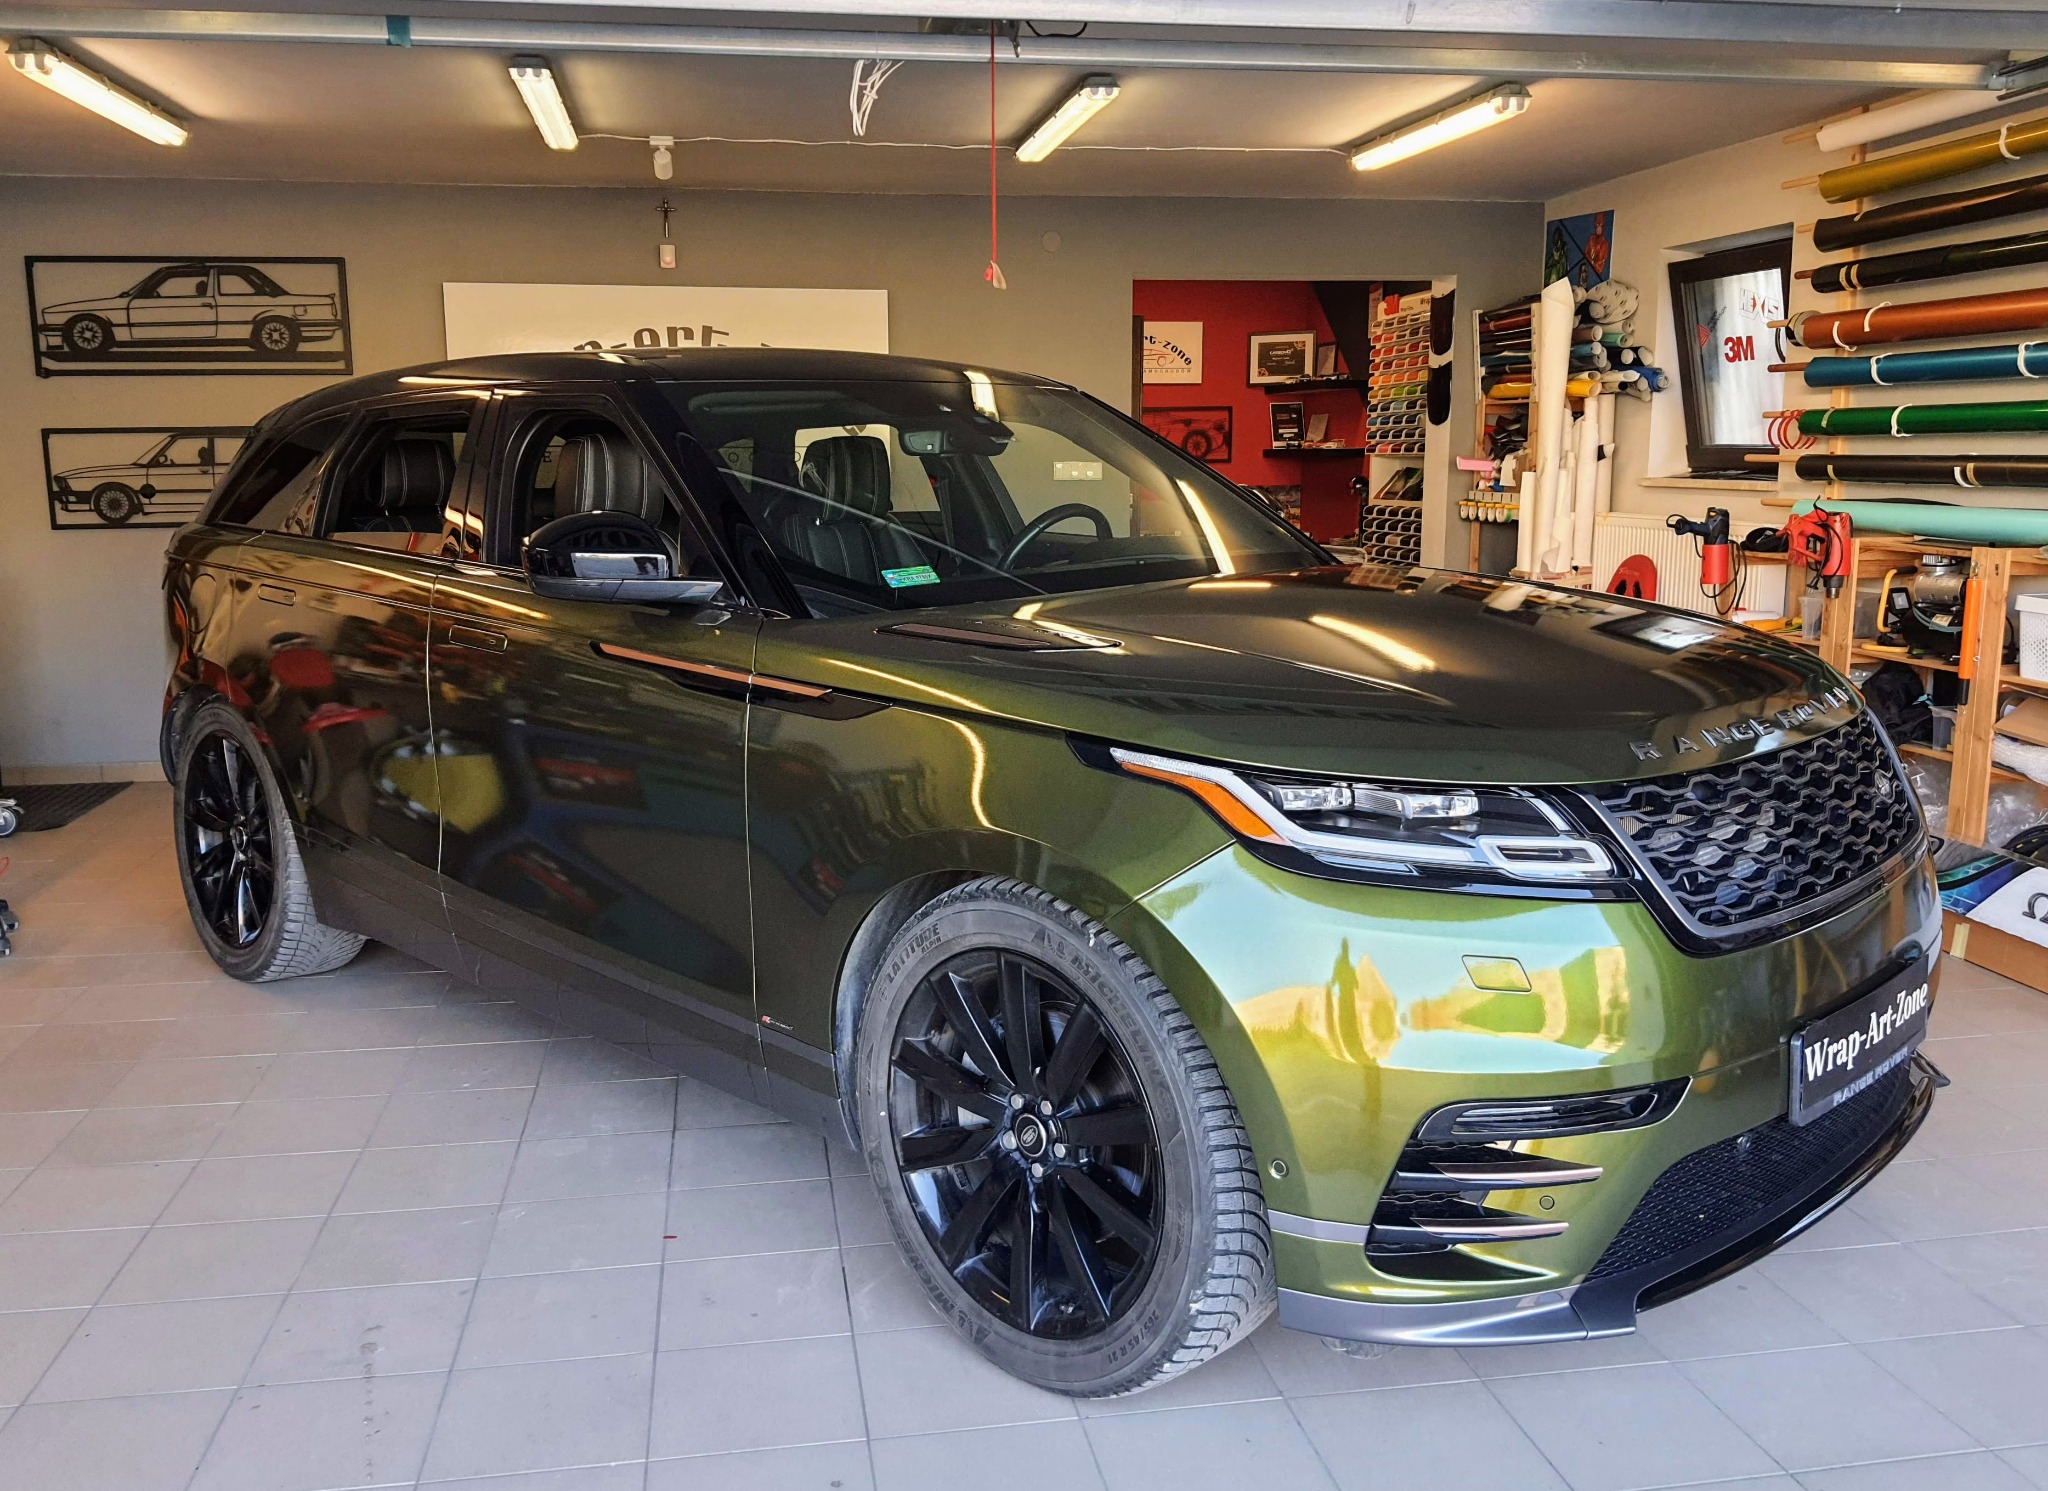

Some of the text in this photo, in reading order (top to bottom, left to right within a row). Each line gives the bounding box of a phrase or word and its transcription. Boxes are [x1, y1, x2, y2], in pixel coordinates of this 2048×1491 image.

[1724, 335, 1755, 363] 3M
[1629, 717, 1776, 760] RANGE
[1804, 982, 1928, 1082] Wrap-Art-Zone
[1833, 1046, 1908, 1107] RANGE ROVER
